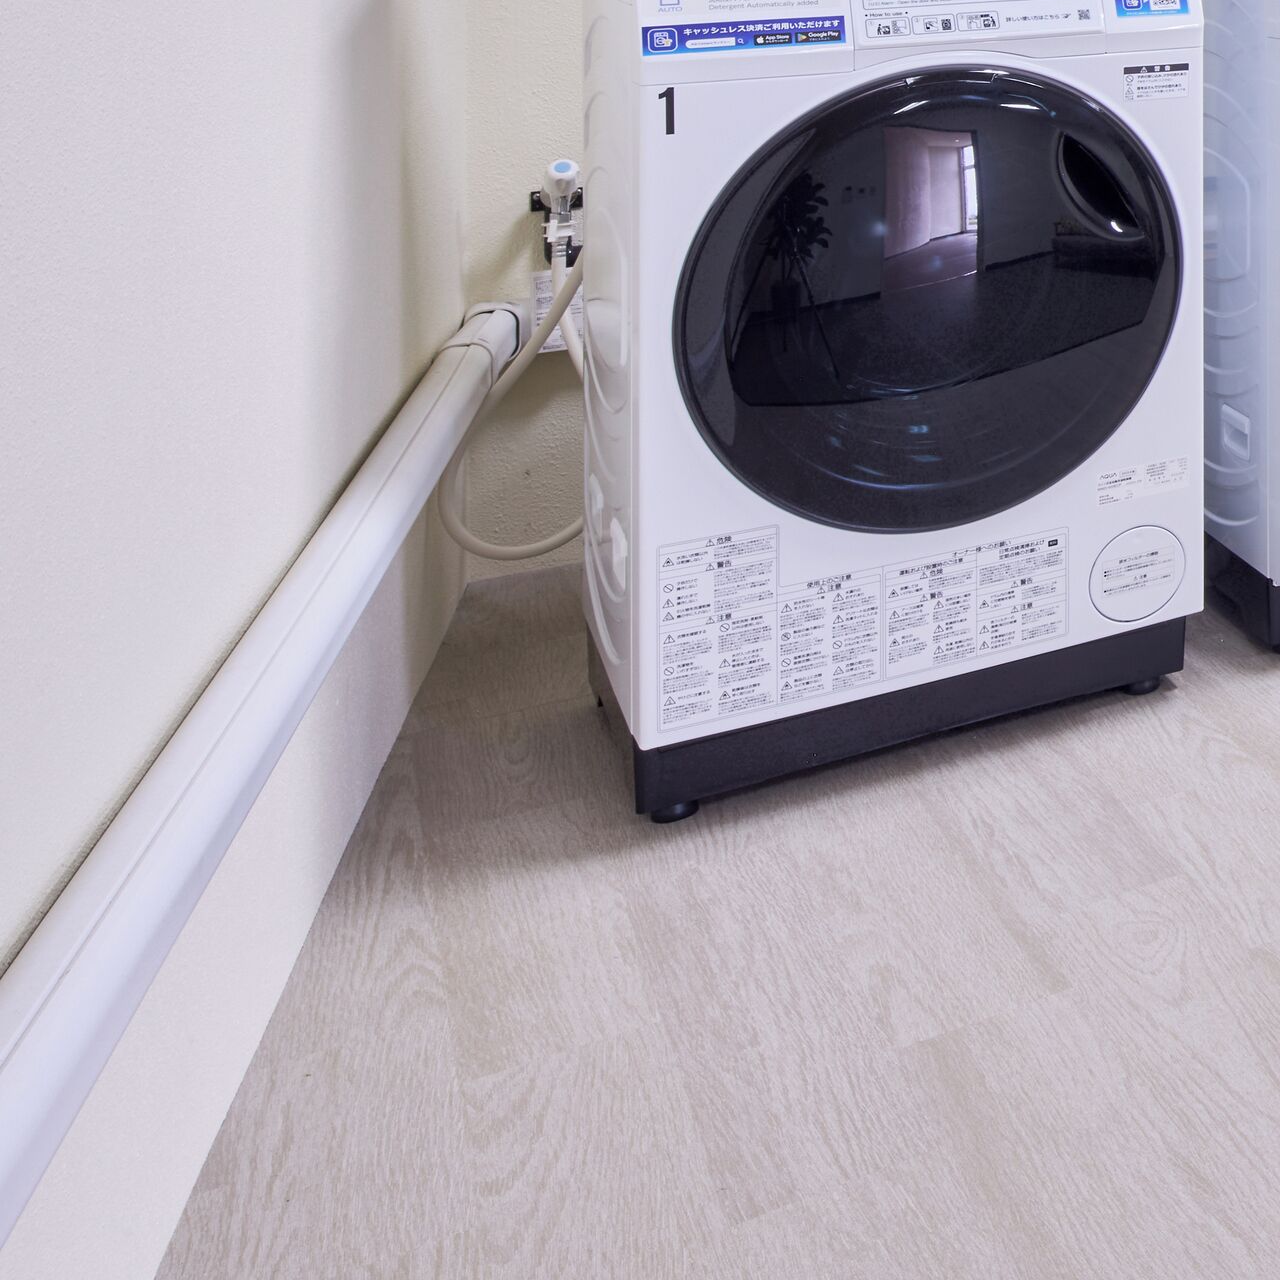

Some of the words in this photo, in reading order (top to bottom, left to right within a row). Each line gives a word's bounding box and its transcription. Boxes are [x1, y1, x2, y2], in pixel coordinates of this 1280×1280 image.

[709, 3, 745, 11] Detergent
[747, 1, 796, 9] Automatically
[797, 0, 819, 7] added
[684, 20, 840, 36] キャッシュレス決済ご利用いただけます
[658, 87, 675, 135] 1
